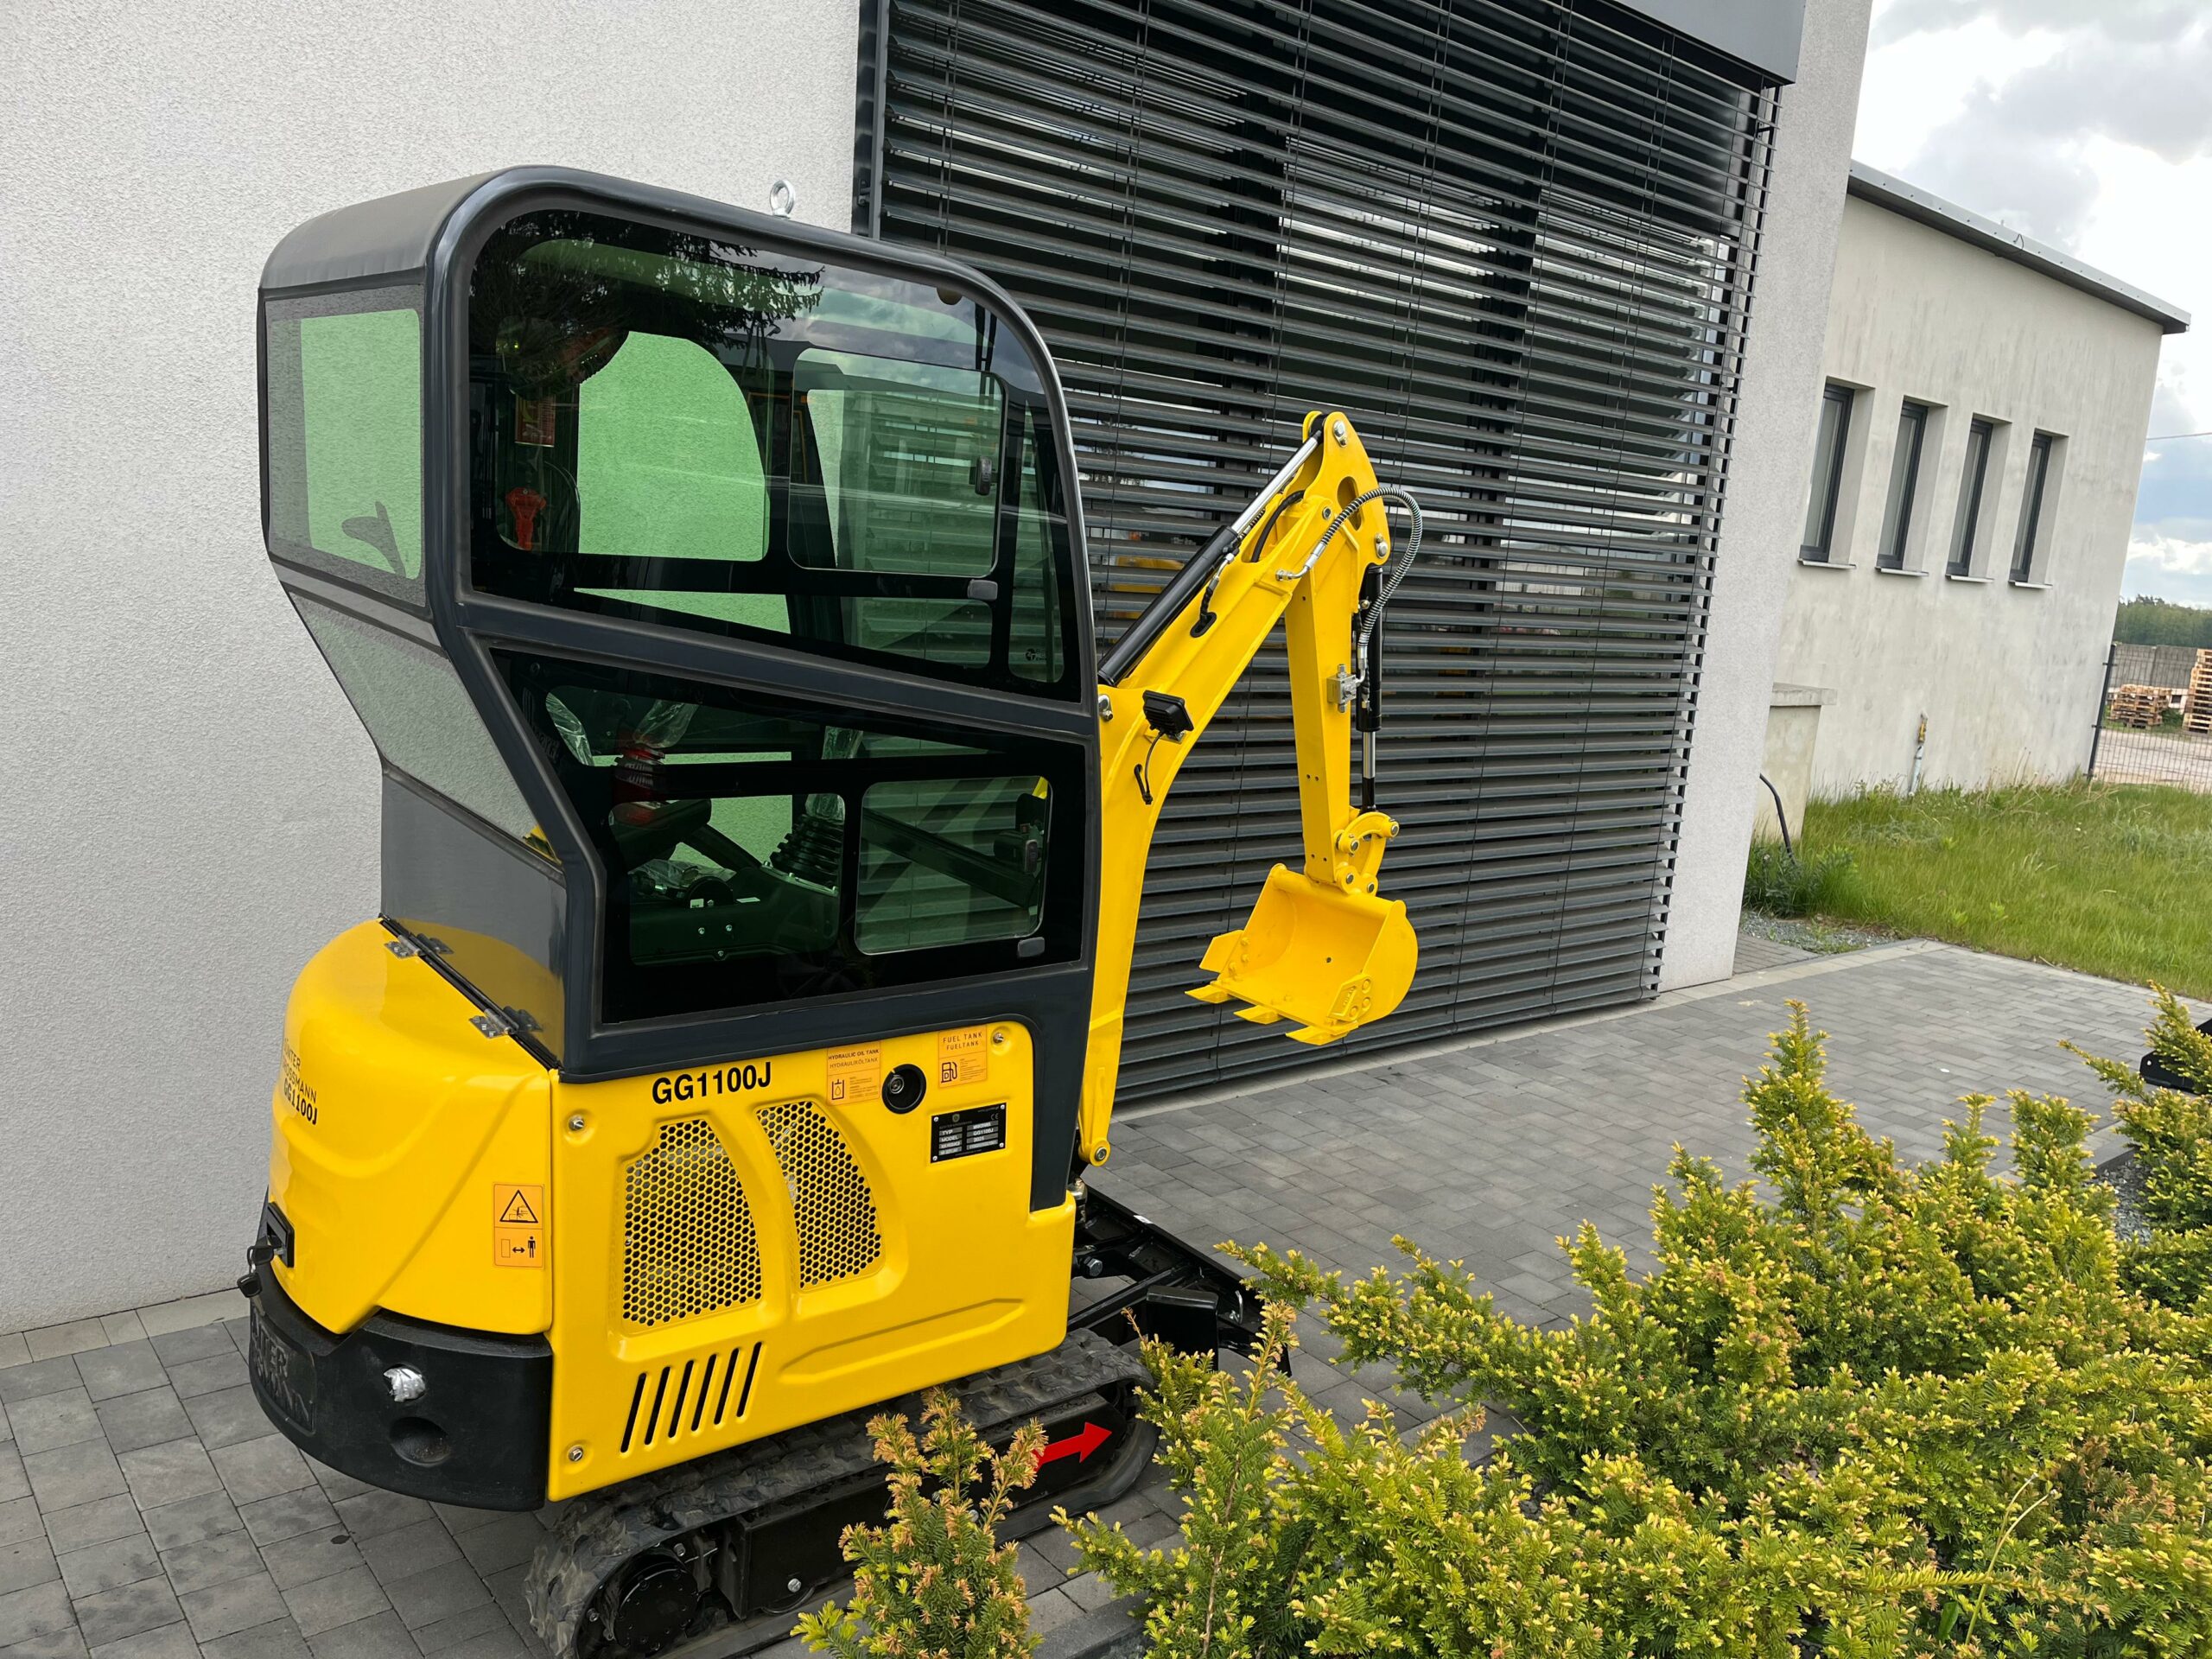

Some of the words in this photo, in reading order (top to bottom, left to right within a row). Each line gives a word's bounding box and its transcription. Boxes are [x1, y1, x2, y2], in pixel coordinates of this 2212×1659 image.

[828, 1052, 856, 1061] HYDRAULIC
[946, 1040, 979, 1051] FUELTANK
[652, 1061, 771, 1104] GG1100J
[283, 1077, 318, 1126] GG1100J
